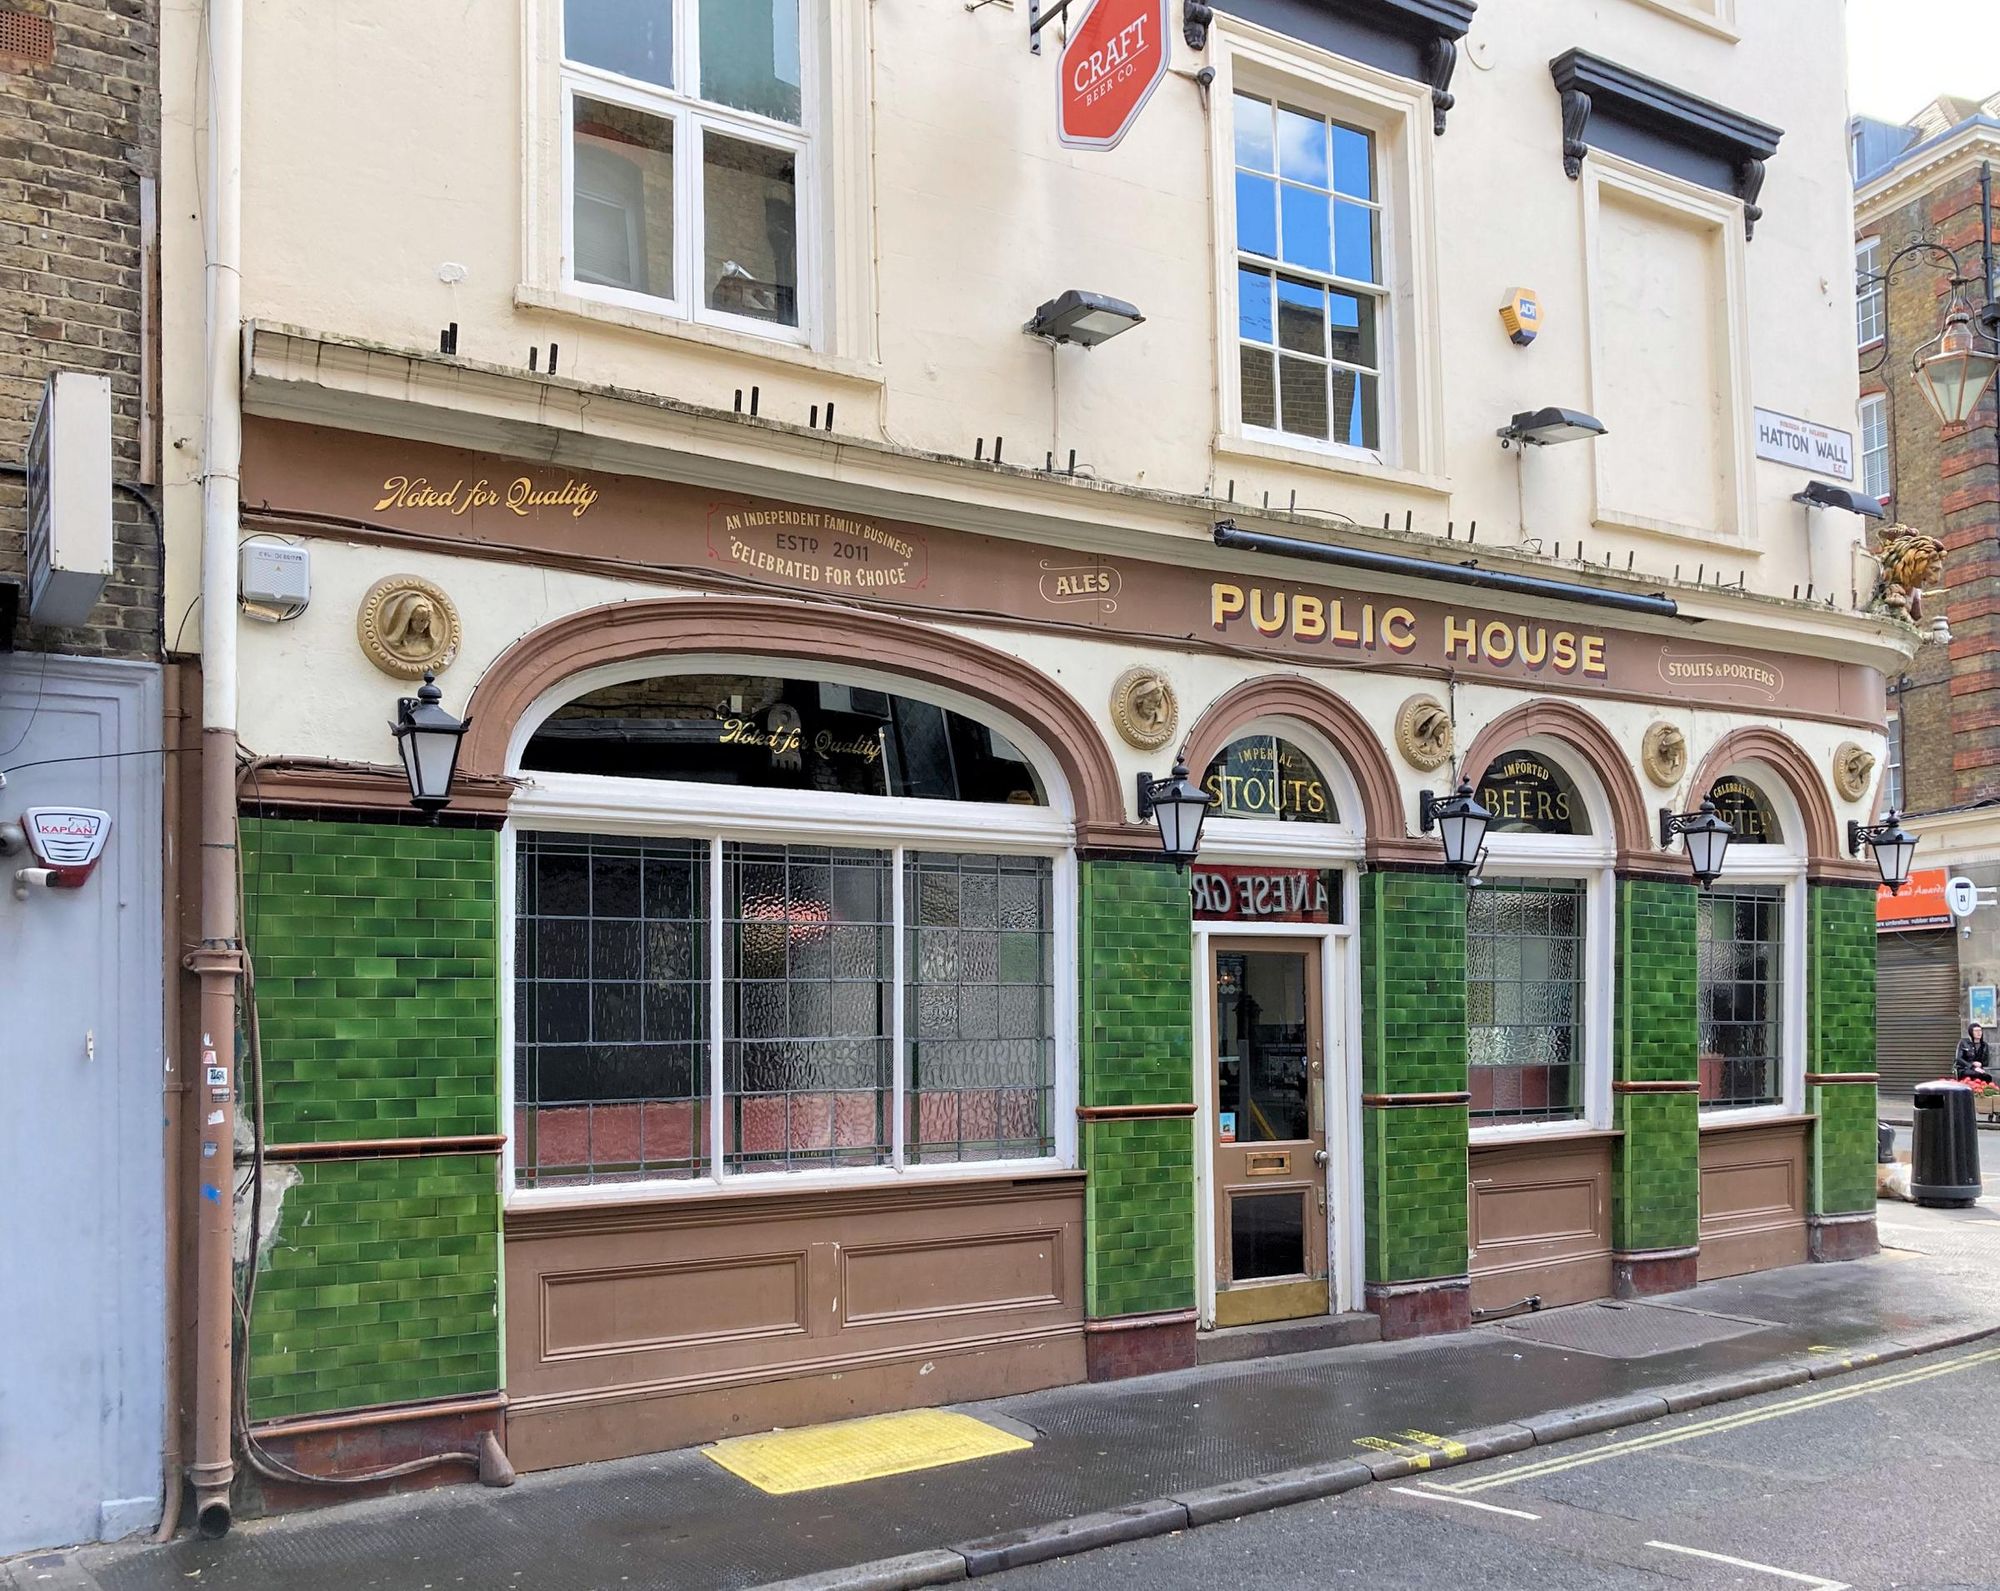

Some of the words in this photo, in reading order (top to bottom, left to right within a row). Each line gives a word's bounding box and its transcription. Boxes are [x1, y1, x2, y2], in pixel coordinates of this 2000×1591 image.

[1074, 13, 1148, 92] CRAFT
[1086, 78, 1114, 107] BEER
[1117, 63, 1137, 83] CO.
[1520, 302, 1536, 317] ADT
[1760, 424, 1809, 454] HATTON
[1815, 439, 1848, 464] WALL
[373, 475, 463, 512] Noted
[451, 478, 500, 515] for
[505, 477, 599, 517] Quality
[725, 515, 742, 531] AN
[744, 510, 821, 528] INDEPENDENT
[823, 514, 862, 537] FAMILY
[863, 524, 914, 559] BUSINESS
[833, 541, 869, 563] 2011
[824, 566, 852, 586] FOR
[1056, 572, 1111, 597] ALES
[1211, 583, 1417, 654] PUBLIC
[1444, 615, 1607, 679] HOUSE
[719, 718, 784, 750] Noted
[773, 728, 810, 755] for
[812, 729, 881, 765] Quality
[1503, 761, 1549, 781] IMPORTED
[1206, 774, 1326, 814] STOUTS
[1484, 787, 1571, 820] BEERS
[1713, 782, 1756, 799] CELEBRATED
[41, 825, 93, 834] KAPLAN
